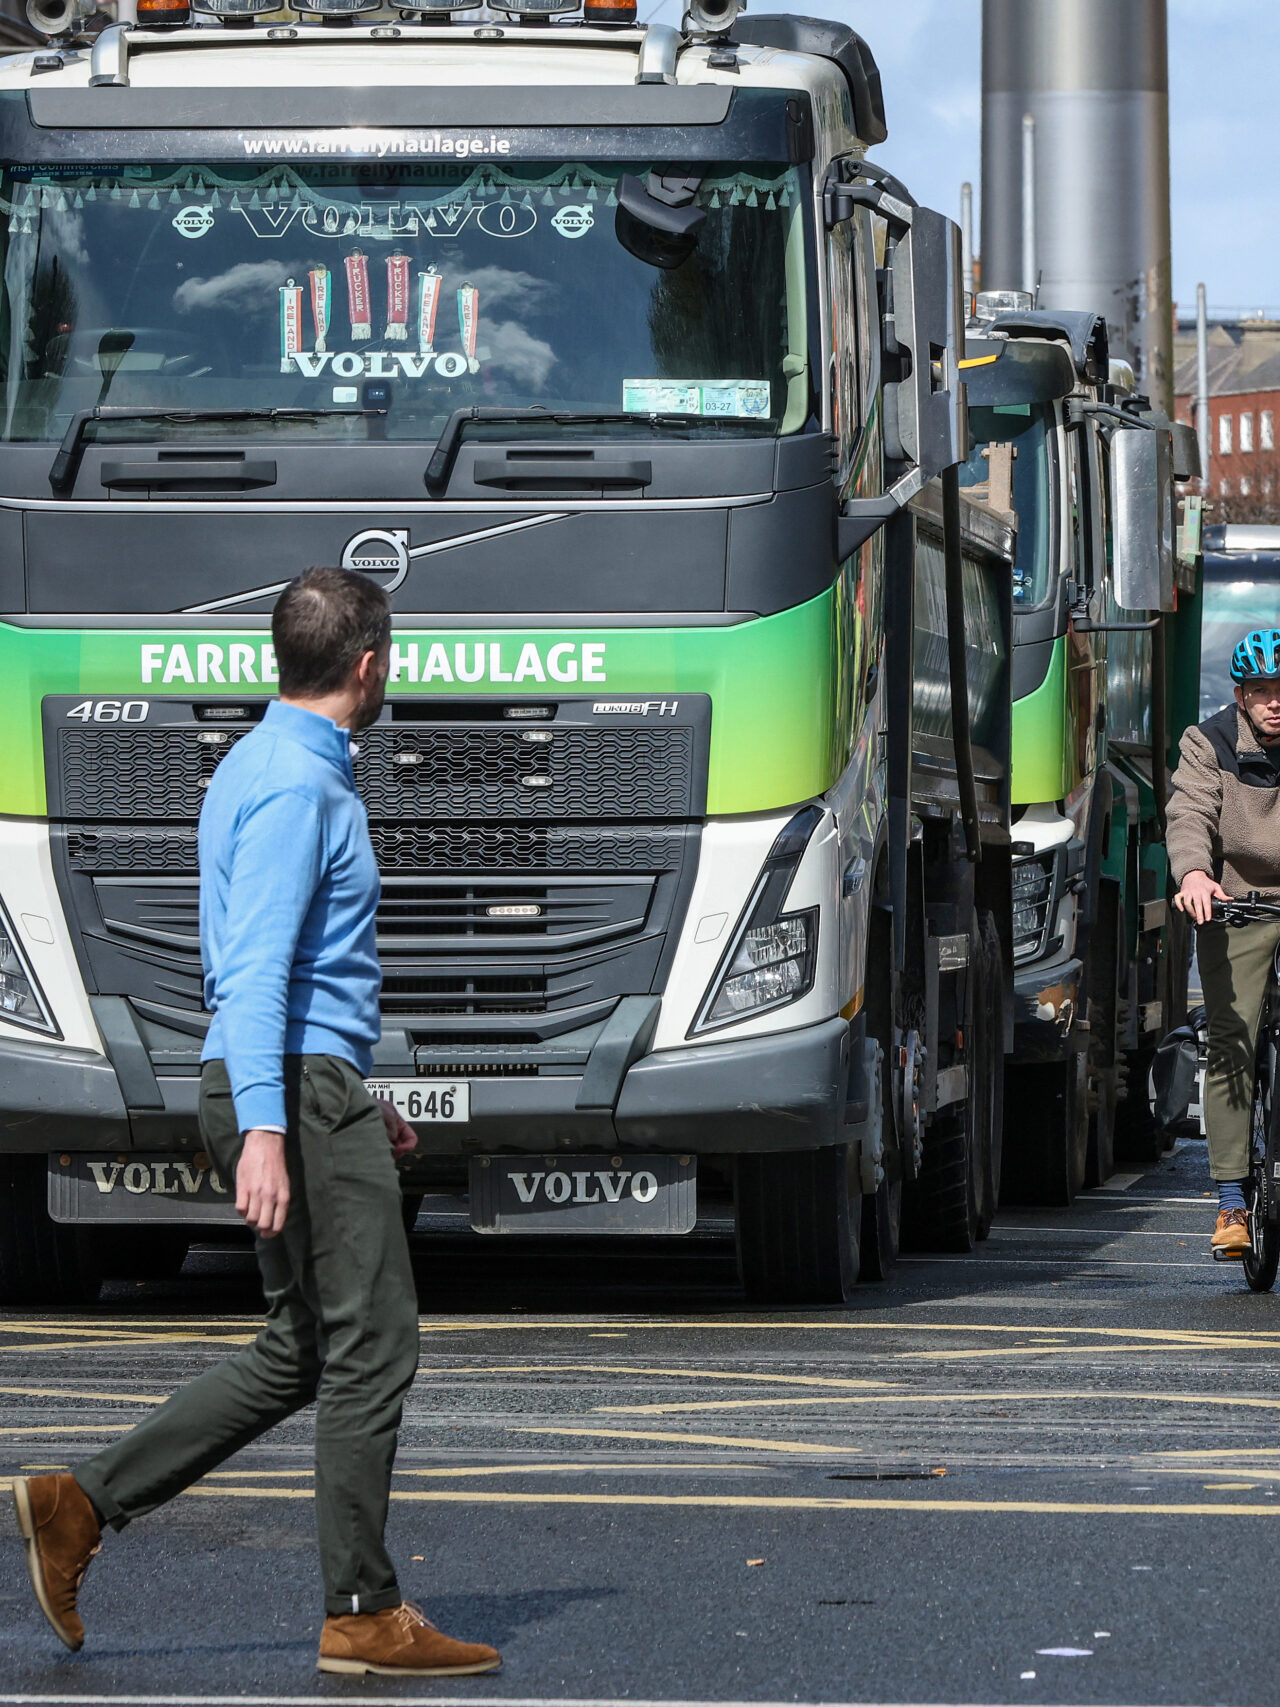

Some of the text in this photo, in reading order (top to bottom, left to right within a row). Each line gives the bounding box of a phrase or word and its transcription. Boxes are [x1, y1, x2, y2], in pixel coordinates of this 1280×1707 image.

[175, 218, 214, 226] VOLVO
[231, 201, 538, 238] VOLVO
[554, 218, 594, 226] VOLVO
[351, 260, 365, 312] TRUCKER
[393, 260, 403, 312] TRUCKER
[317, 278, 325, 332] IRELAND
[421, 286, 433, 336] IRELAND
[286, 298, 295, 350] IRELAND
[463, 297, 472, 351] IRELAND
[288, 351, 468, 378] VOLVO
[705, 402, 732, 411] 03-27
[351, 559, 400, 567] VOLVO
[140, 643, 607, 684] FARRE HAULAGE
[66, 700, 150, 723] 460
[372, 1090, 455, 1119] -646
[507, 1170, 659, 1204] VOLVO
